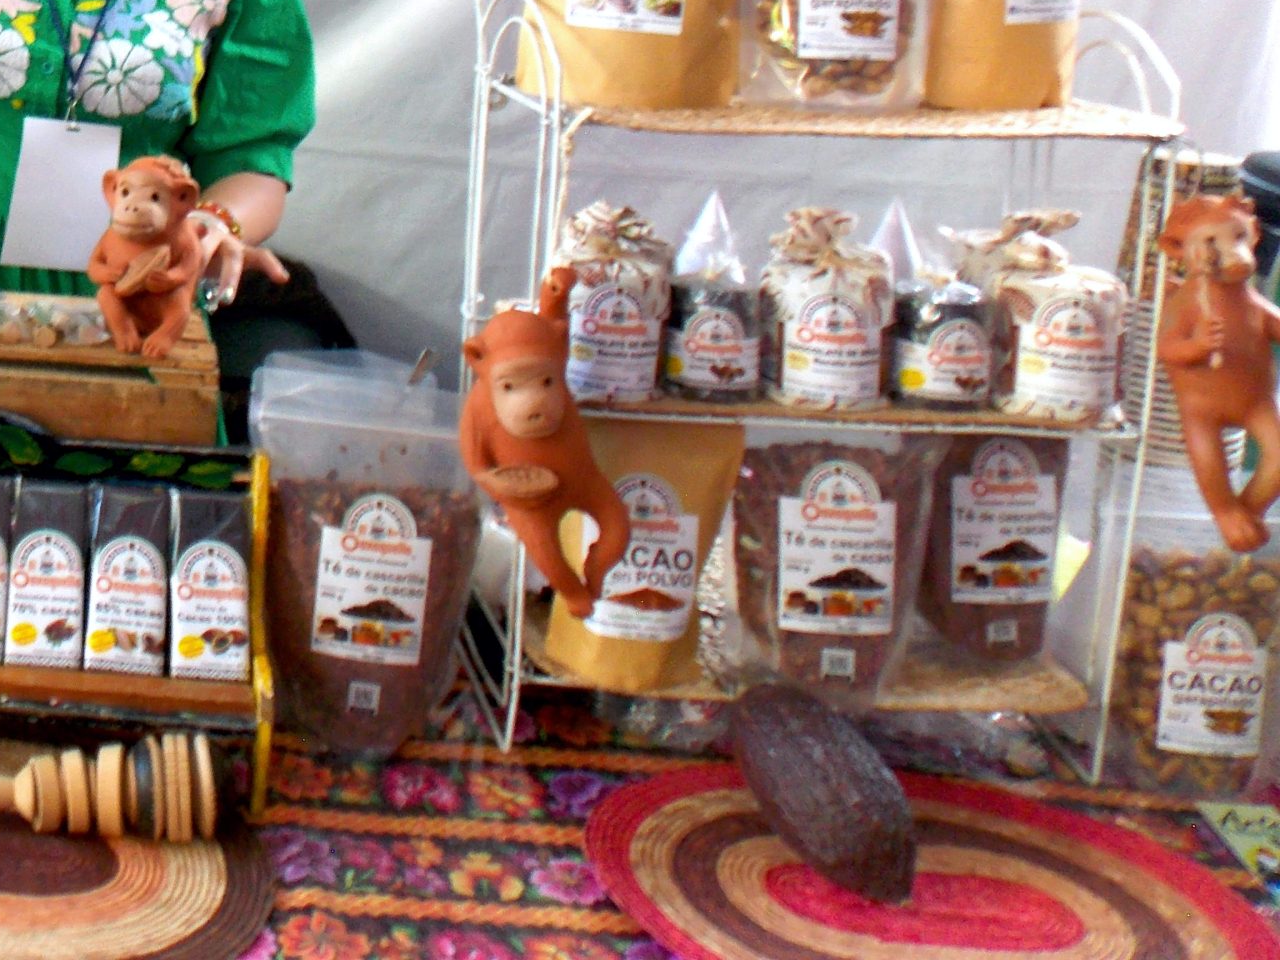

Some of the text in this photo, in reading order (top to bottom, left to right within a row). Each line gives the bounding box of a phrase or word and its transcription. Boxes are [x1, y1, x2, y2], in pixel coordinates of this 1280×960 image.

[784, 529, 805, 545] Té
[808, 537, 826, 548] de
[622, 546, 693, 571] CAO
[849, 553, 893, 565] cacao
[322, 559, 342, 577] Té
[346, 566, 361, 578] de
[364, 568, 425, 585] cascarilla
[637, 572, 693, 588] POLVO
[365, 583, 424, 598] de cacao
[1167, 670, 1263, 695] CACAO
